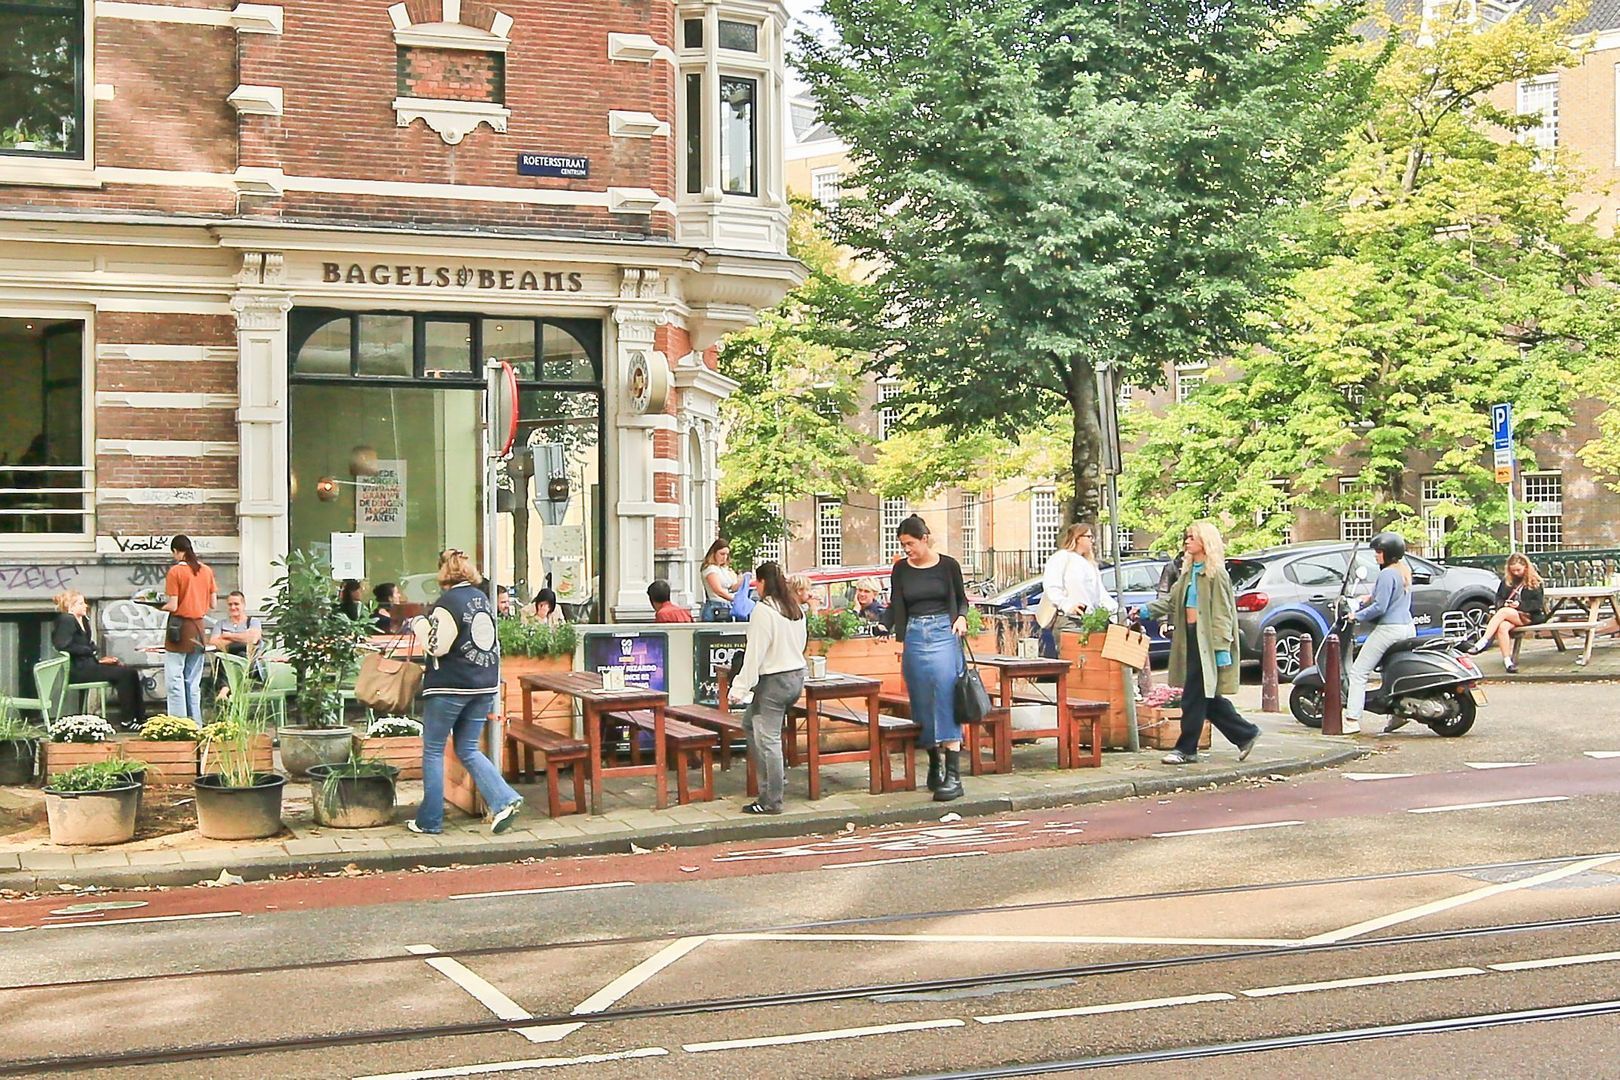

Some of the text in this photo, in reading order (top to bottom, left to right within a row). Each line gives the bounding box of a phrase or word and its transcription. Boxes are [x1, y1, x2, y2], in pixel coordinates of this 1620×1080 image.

[523, 155, 586, 169] ROETERSSTRAAT
[560, 168, 586, 176] CENTRUM
[322, 262, 451, 288] BAGELS
[478, 268, 583, 292] BEANS
[1495, 408, 1506, 433] P
